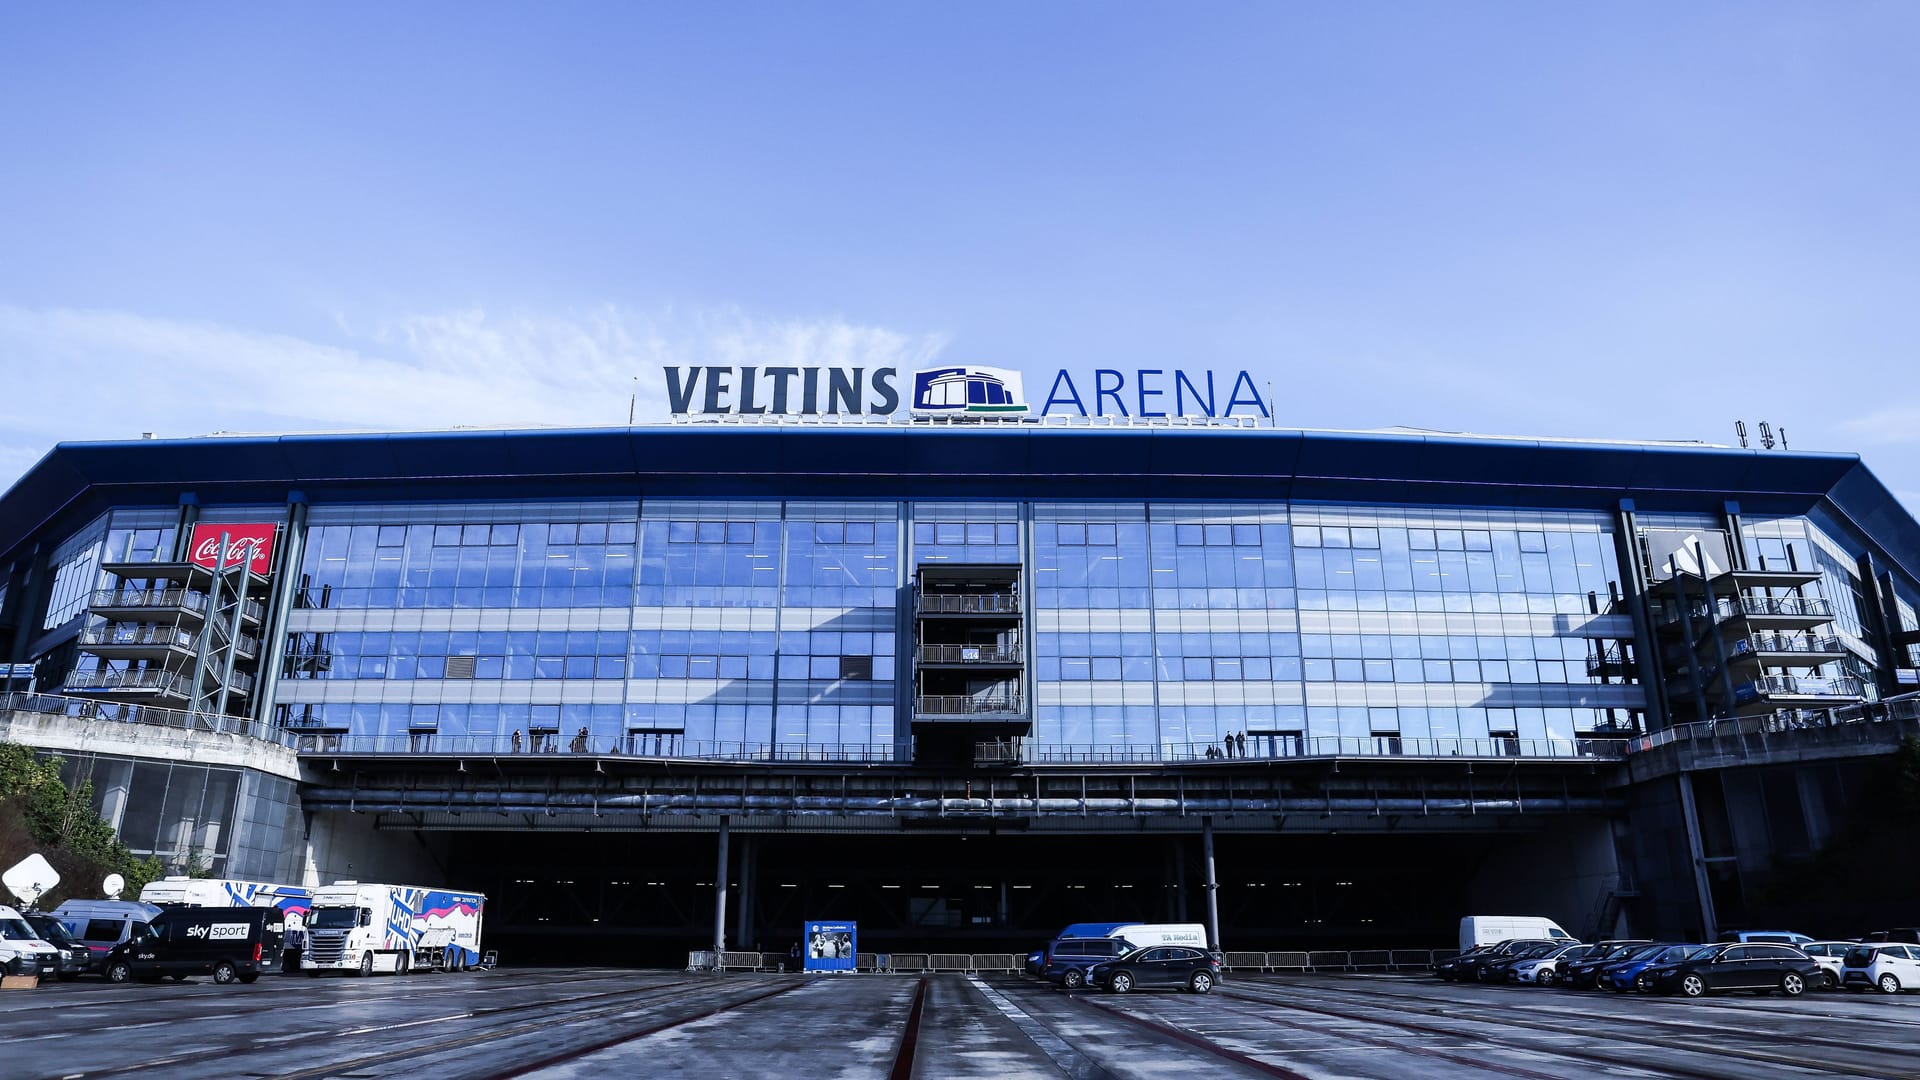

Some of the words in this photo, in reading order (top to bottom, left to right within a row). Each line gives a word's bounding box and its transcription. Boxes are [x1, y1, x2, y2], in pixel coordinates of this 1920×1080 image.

[663, 366, 899, 415] VELTINS
[1040, 368, 1270, 418] ARENA
[391, 903, 412, 934] UHD
[186, 924, 210, 939] sky
[212, 925, 247, 938] sport
[1173, 933, 1198, 941] Media
[138, 952, 156, 960] sky.de
